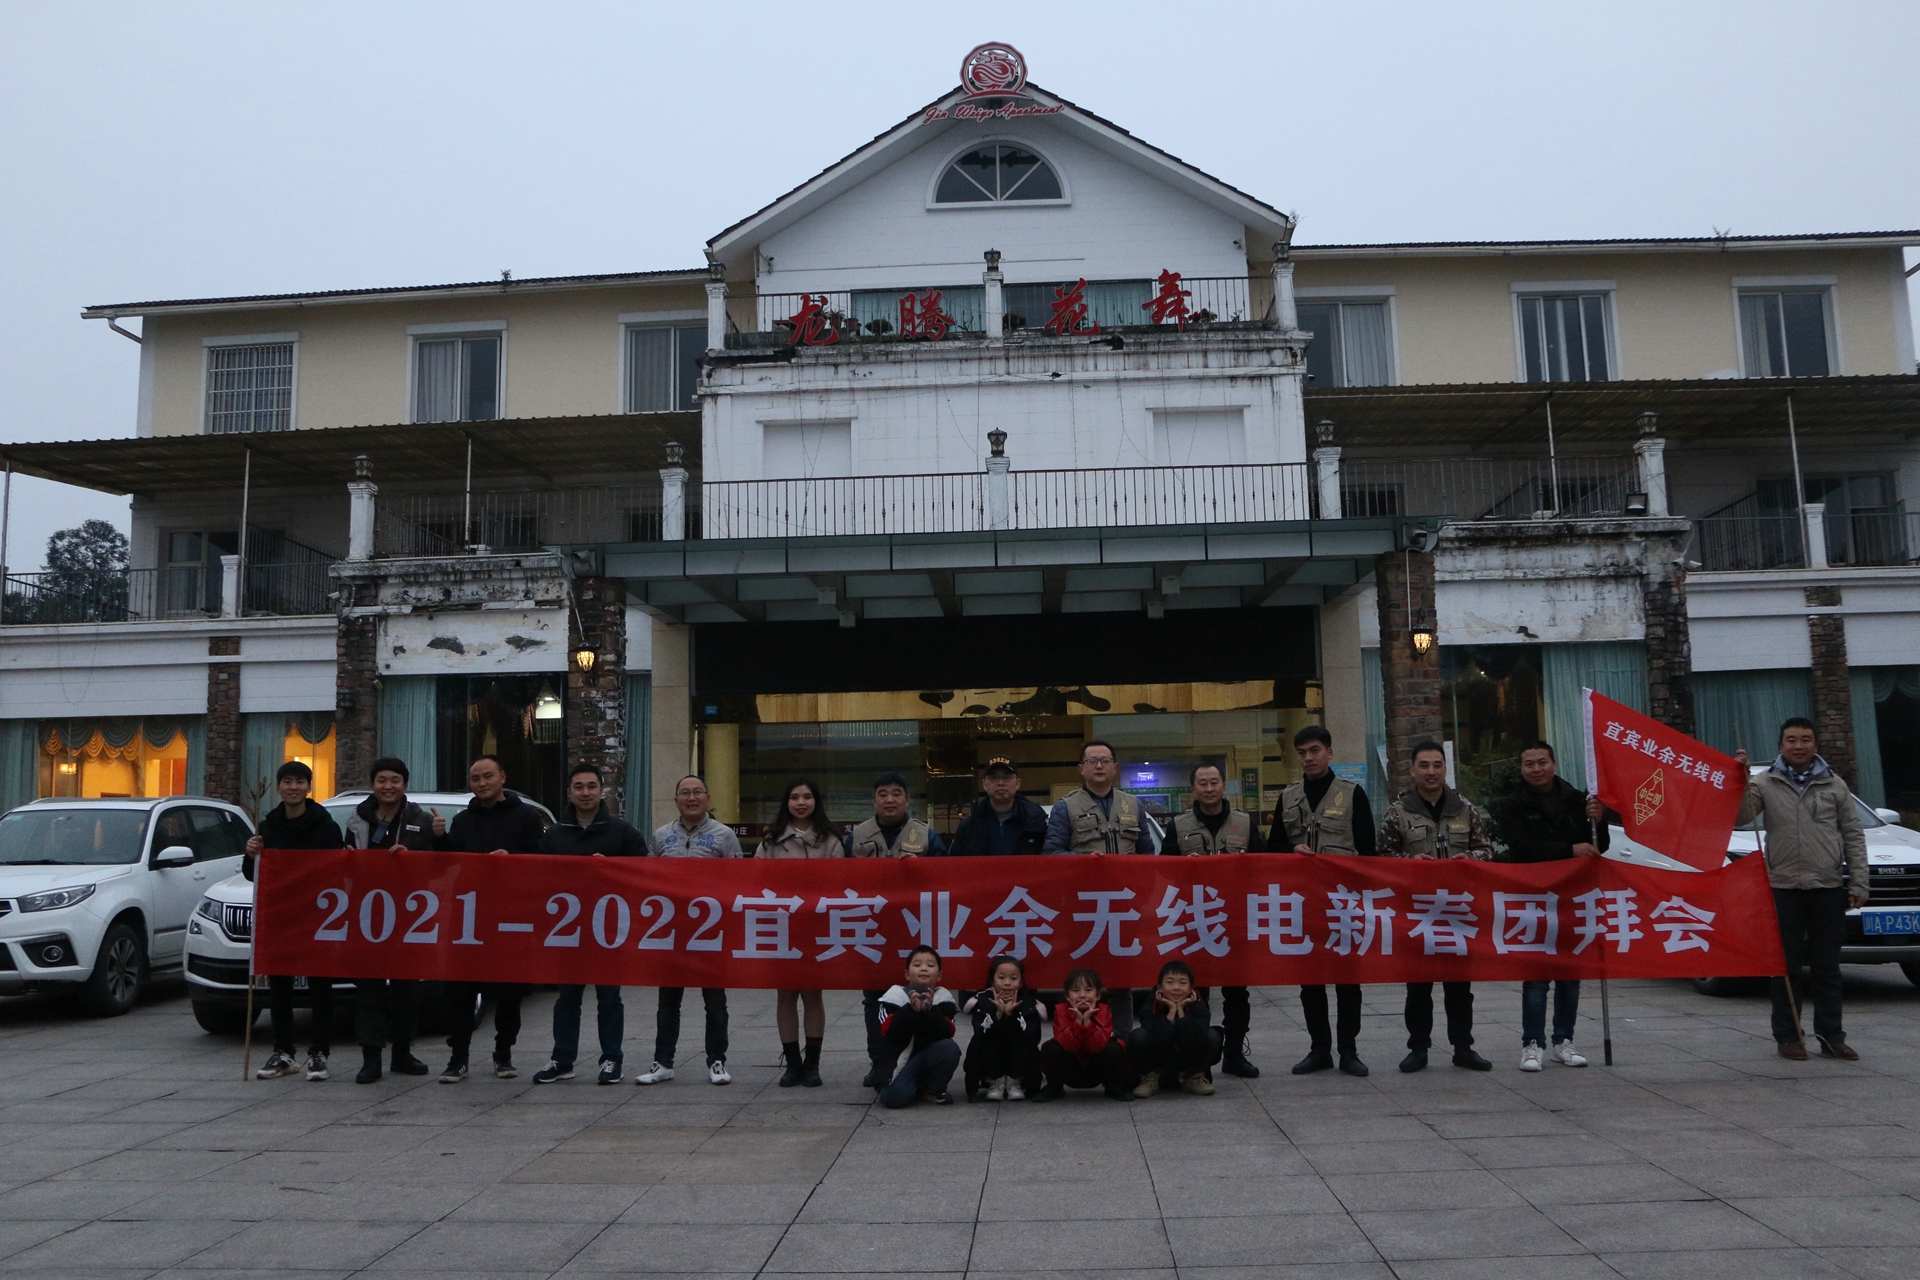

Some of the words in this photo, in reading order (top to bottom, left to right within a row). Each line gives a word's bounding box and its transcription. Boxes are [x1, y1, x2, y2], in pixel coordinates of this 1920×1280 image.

[923, 106, 948, 125] Jin
[996, 102, 1065, 120] Apartment
[1602, 720, 1726, 789] 宜宾业余无线电
